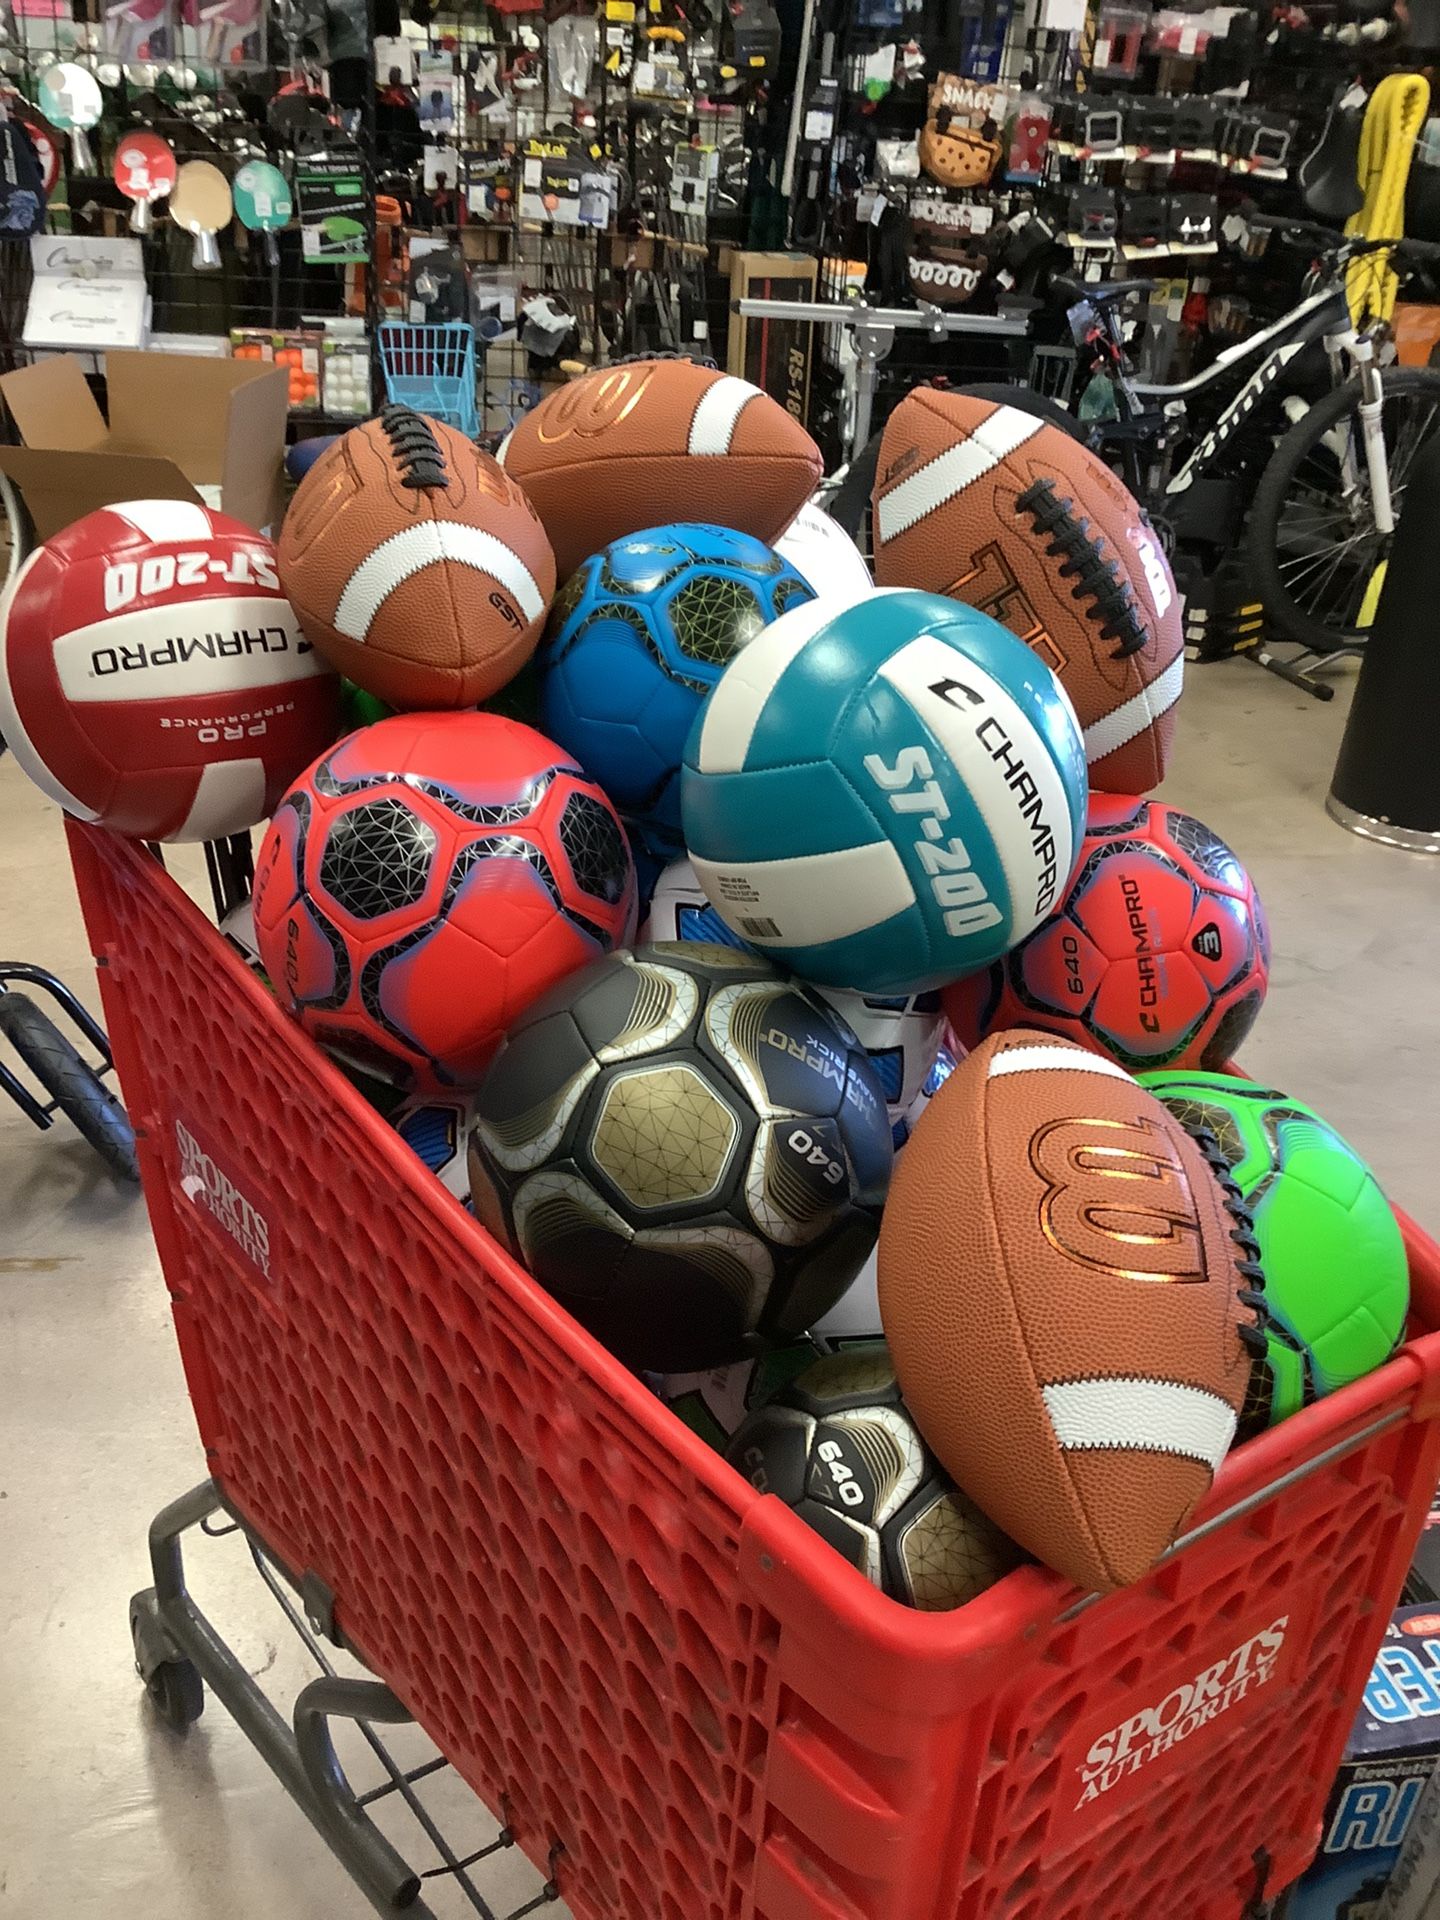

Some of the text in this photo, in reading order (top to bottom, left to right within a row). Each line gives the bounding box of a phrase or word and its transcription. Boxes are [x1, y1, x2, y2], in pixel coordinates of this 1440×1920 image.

[786, 347, 804, 422] RS-18
[104, 551, 280, 613] ST-200
[488, 592, 524, 632] GST
[91, 627, 289, 677] CHAMPRO
[159, 702, 295, 728] PERFORMANCE
[197, 719, 267, 744] PRO
[863, 746, 1004, 937] ST-200
[975, 717, 1060, 917] CHAMPRO
[287, 917, 300, 986] 640
[1063, 936, 1084, 995] 640
[1121, 878, 1158, 1014] CHAMPRO
[176, 1119, 270, 1257] SPORTS
[788, 1129, 844, 1185] 640
[817, 1439, 865, 1507] 640
[1080, 1614, 1289, 1784] SPORTS
[1073, 1656, 1278, 1813] AUTHORITY
